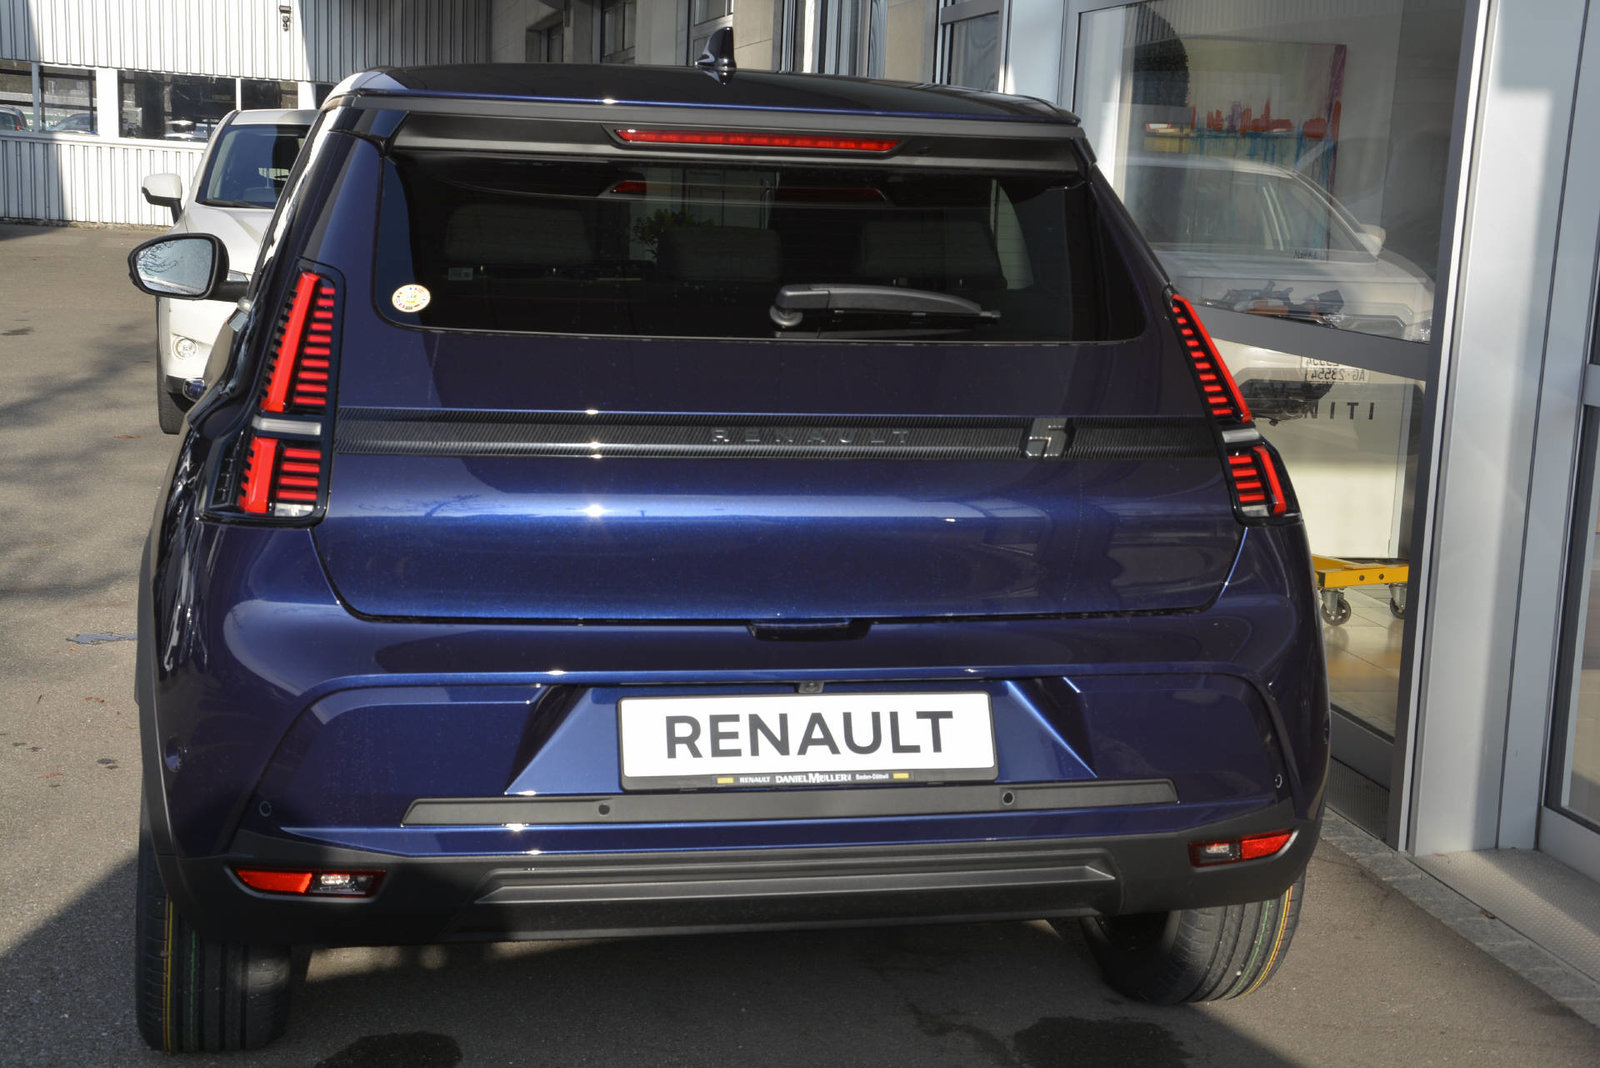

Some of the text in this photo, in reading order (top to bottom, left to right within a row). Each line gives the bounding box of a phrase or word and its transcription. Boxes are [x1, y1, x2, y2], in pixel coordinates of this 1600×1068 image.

[711, 428, 908, 443] RENAULT
[665, 710, 954, 760] RENAULT
[739, 776, 771, 784] RENAULT
